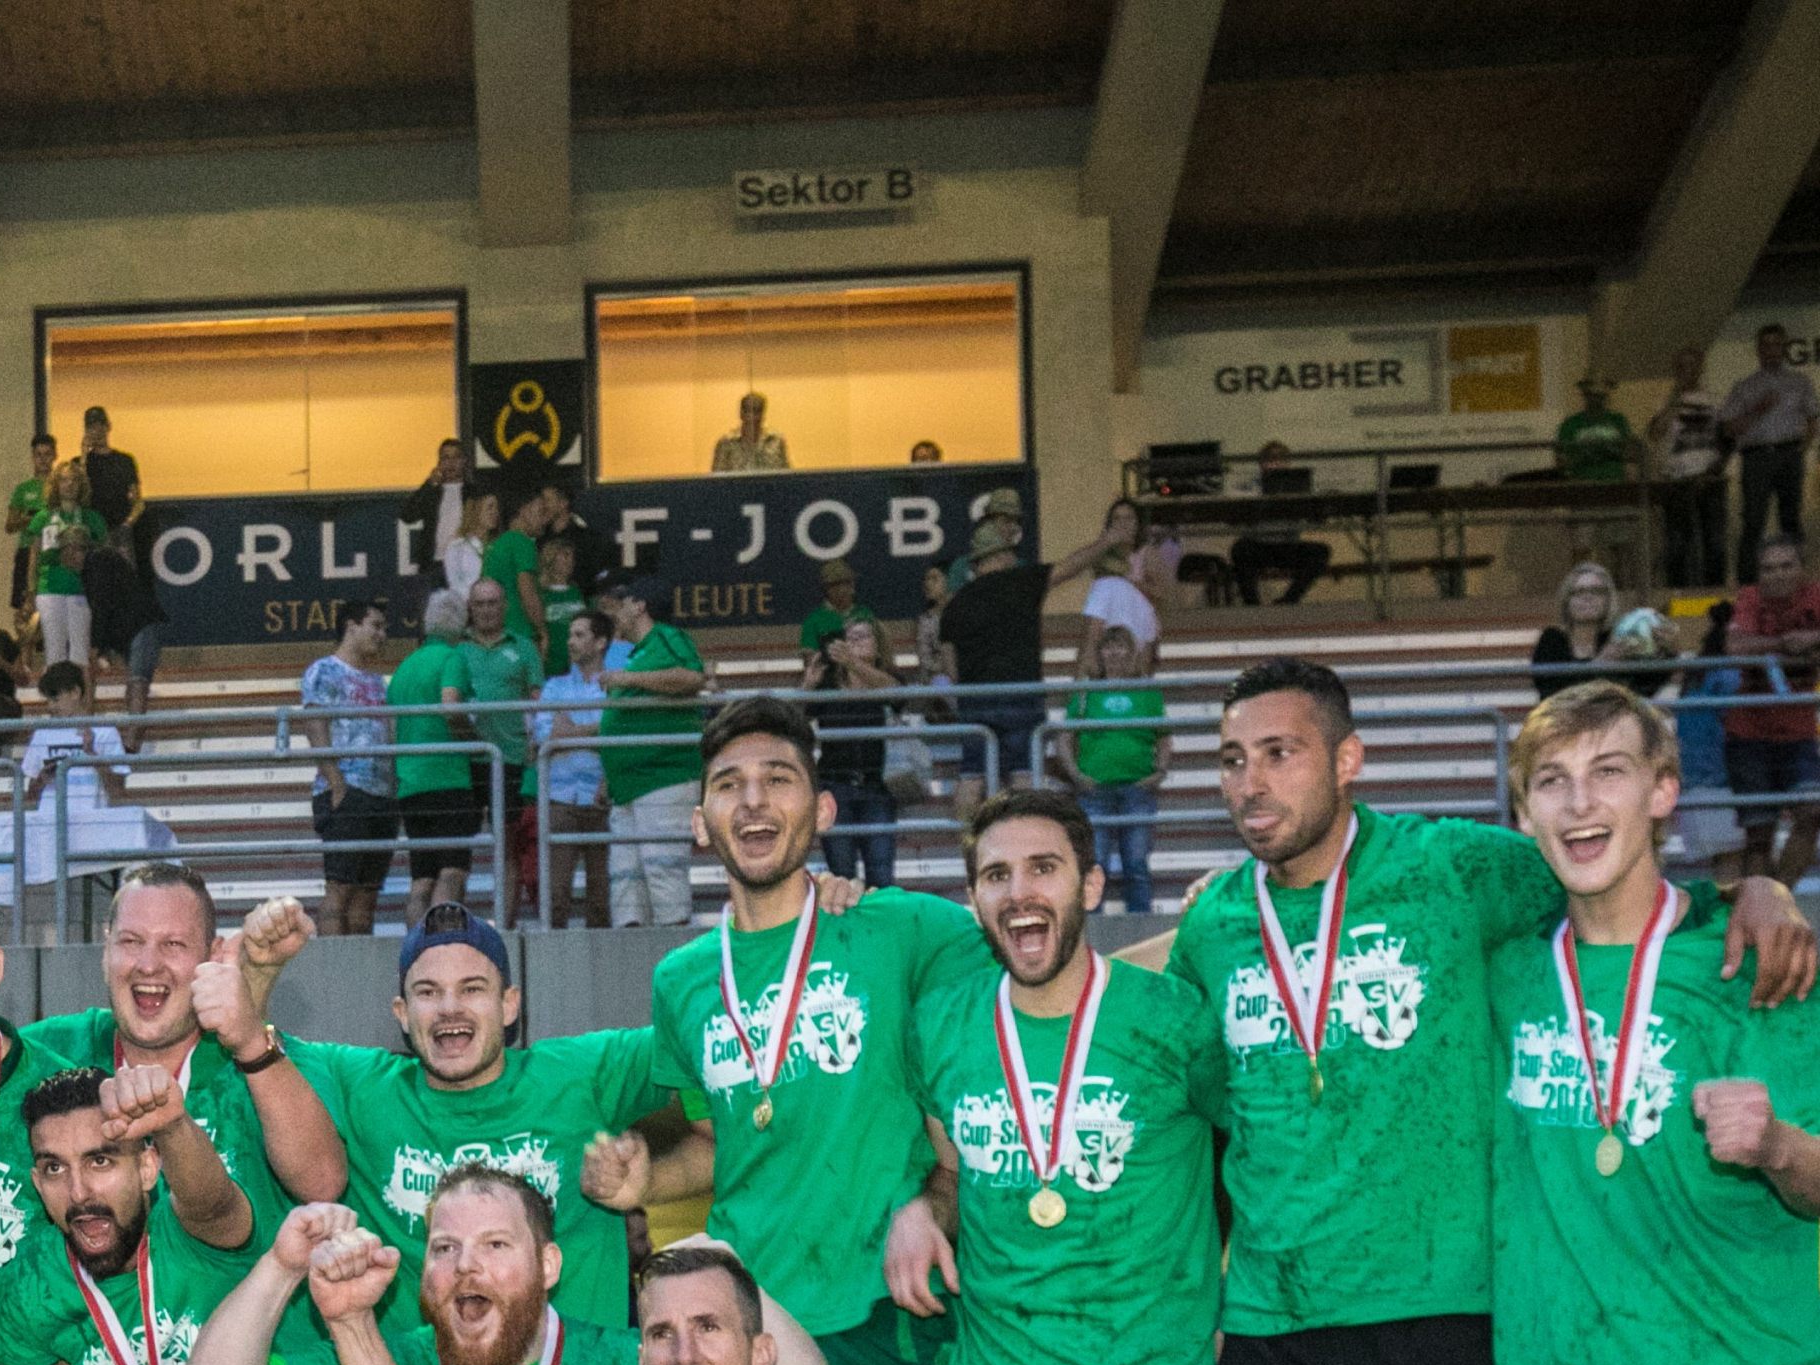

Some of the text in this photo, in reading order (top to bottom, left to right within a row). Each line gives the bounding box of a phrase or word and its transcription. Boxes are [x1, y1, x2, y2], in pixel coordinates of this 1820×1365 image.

[739, 169, 913, 208] Sektor B
[1214, 359, 1403, 394] GRABHER
[673, 582, 773, 618] LEUTE
[1368, 982, 1407, 1009] SV
[816, 1012, 852, 1034] SV
[1269, 1008, 1347, 1057] 28
[1083, 1132, 1122, 1156] SV
